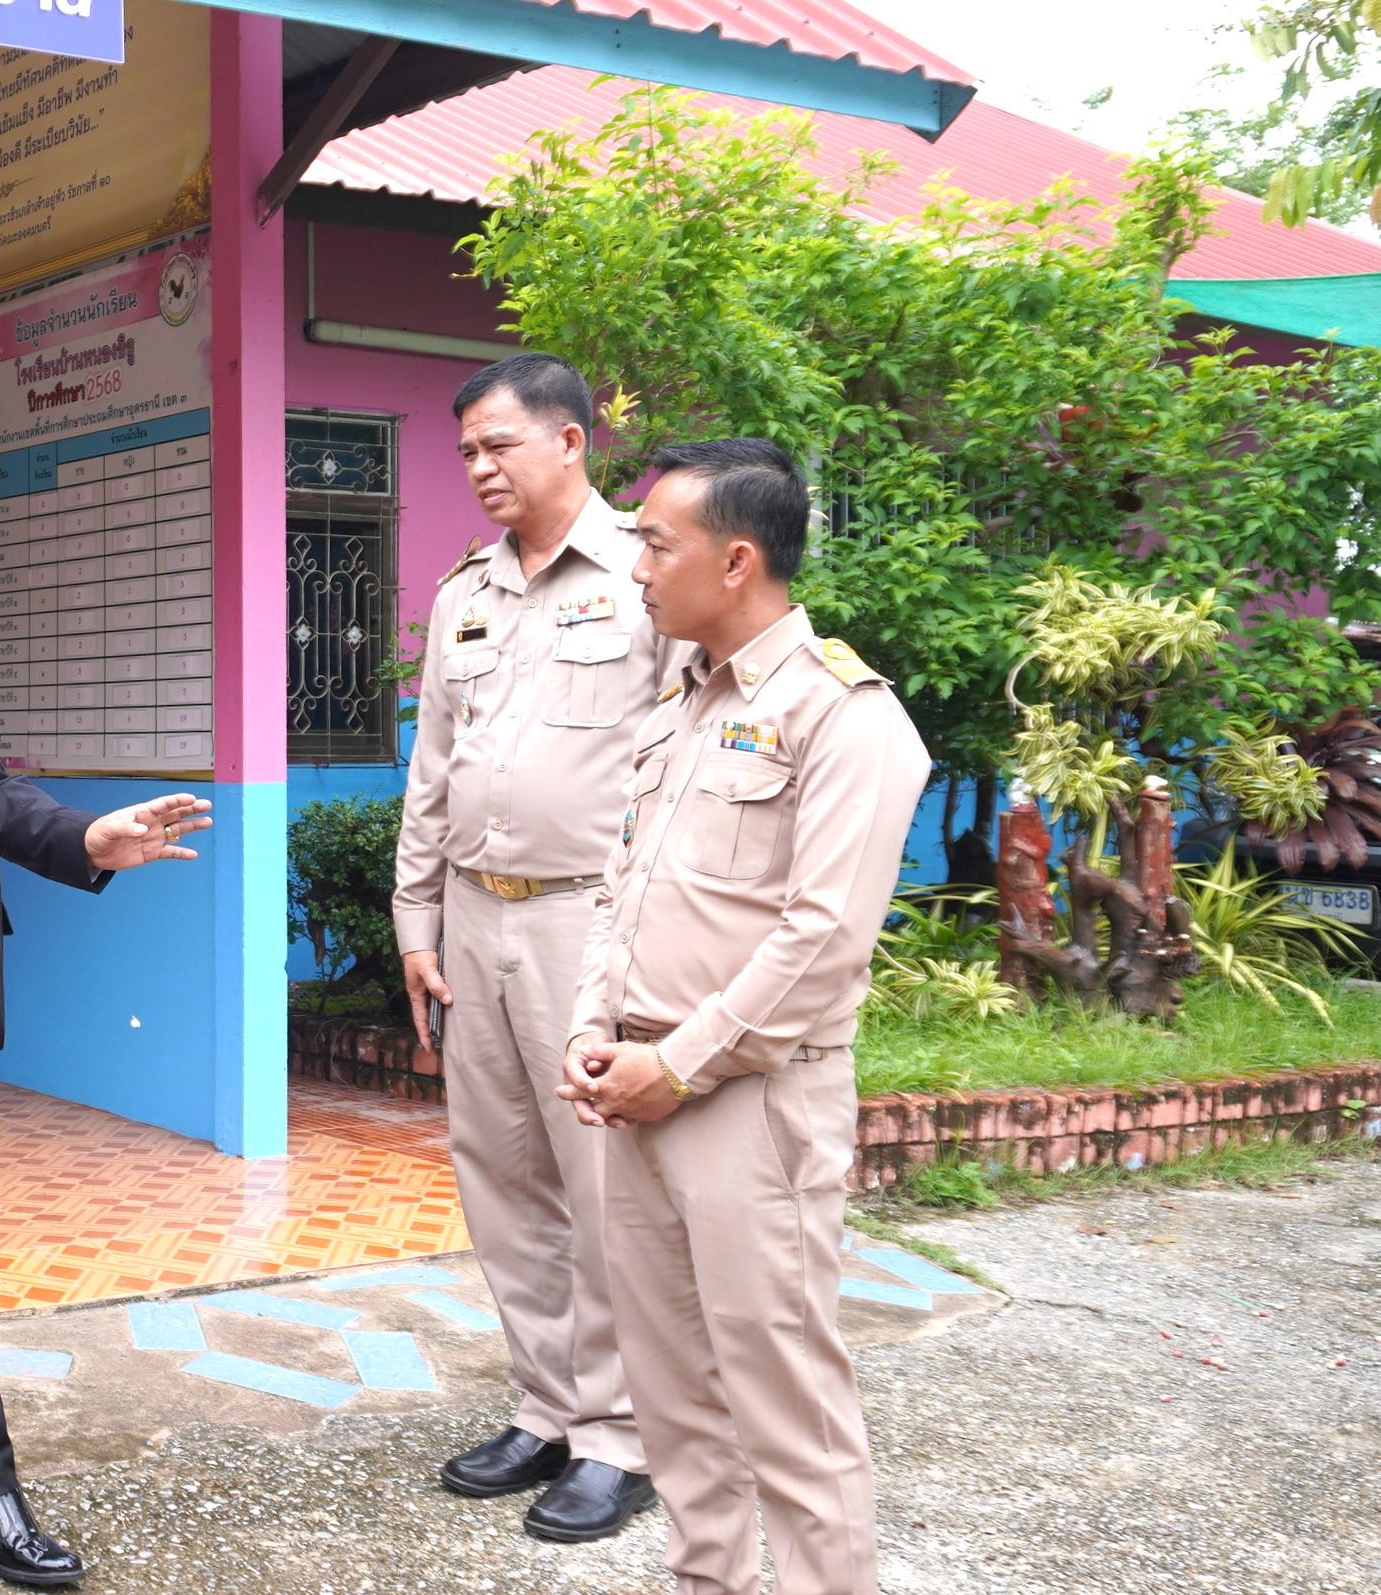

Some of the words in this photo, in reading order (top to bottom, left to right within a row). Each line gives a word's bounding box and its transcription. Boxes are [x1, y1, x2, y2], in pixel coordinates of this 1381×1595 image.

[15, 288, 138, 347] ข้อมูลจำนวนนักเรียน
[86, 369, 122, 401] 2568
